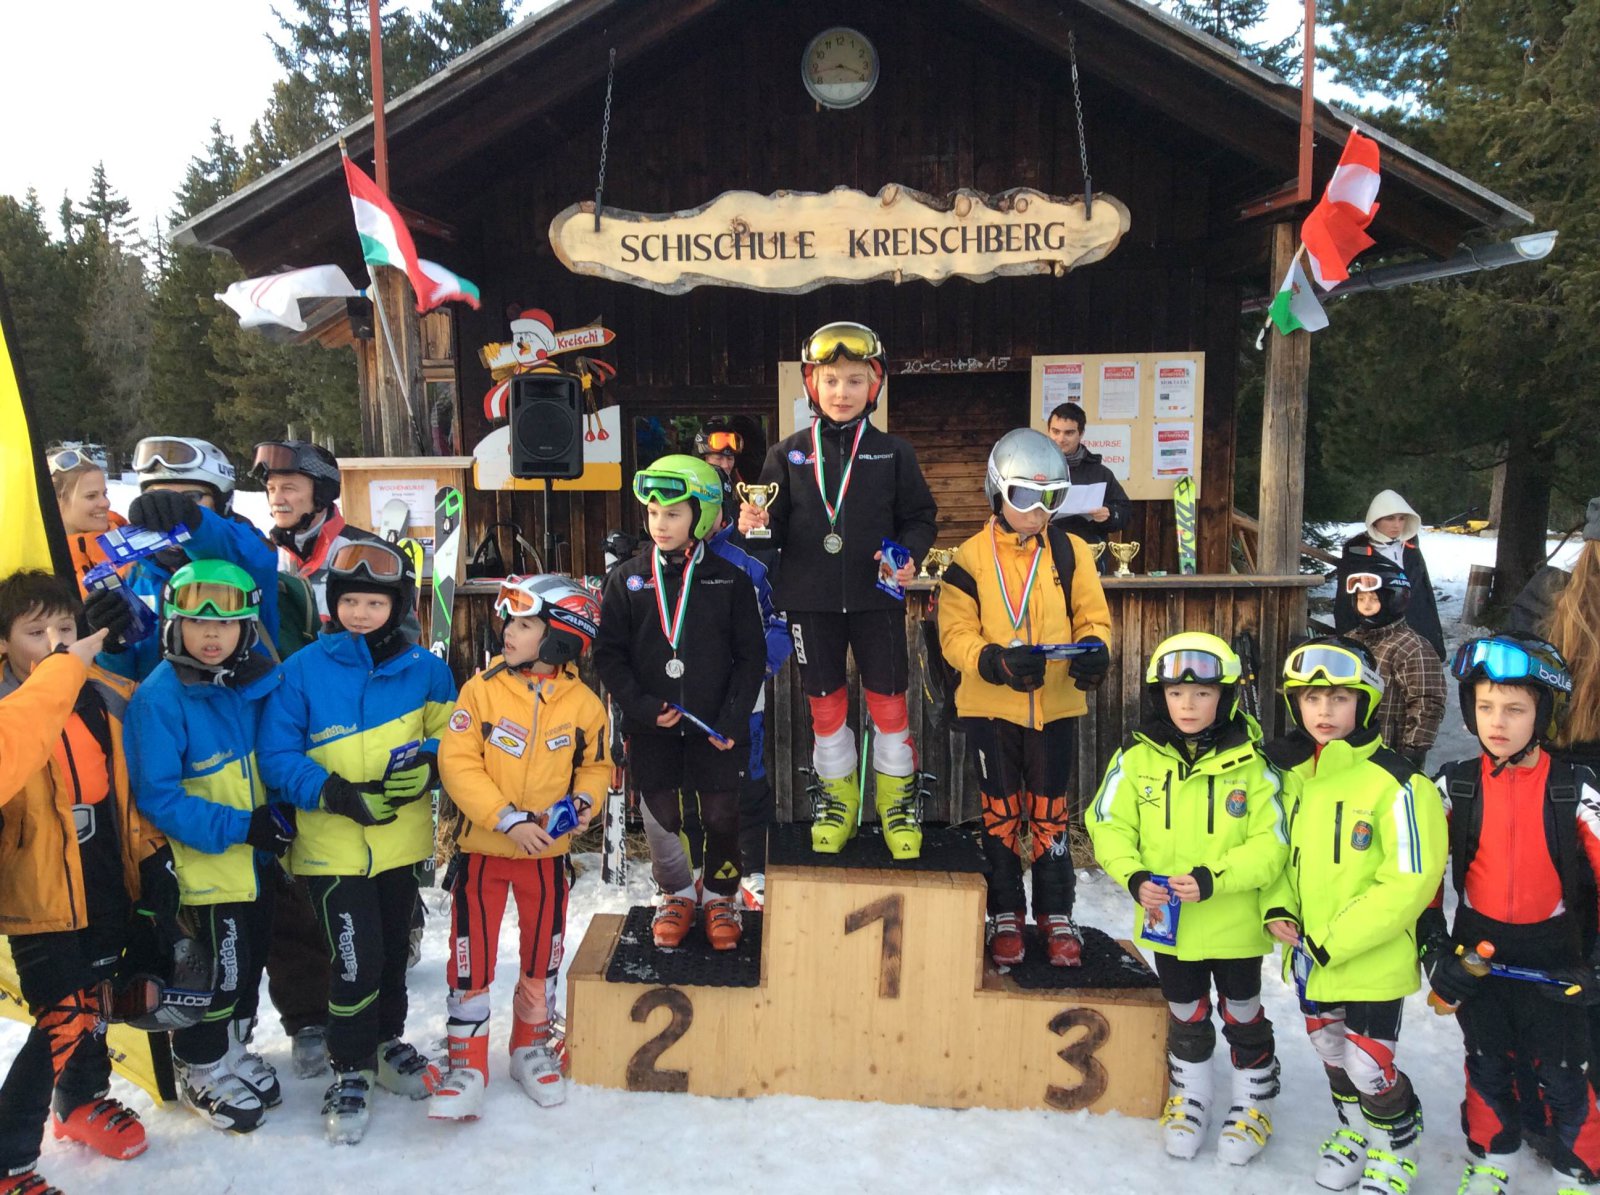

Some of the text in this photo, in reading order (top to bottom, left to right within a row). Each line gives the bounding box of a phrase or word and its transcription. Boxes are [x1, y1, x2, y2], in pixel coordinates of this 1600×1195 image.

[620, 221, 1066, 263] SCHISCHULE KREISCHBERG
[557, 330, 599, 350] Kreischi
[844, 894, 905, 999] 1
[162, 993, 213, 1007] SCOTT
[626, 987, 694, 1092] 2
[1043, 1007, 1111, 1110] 3
